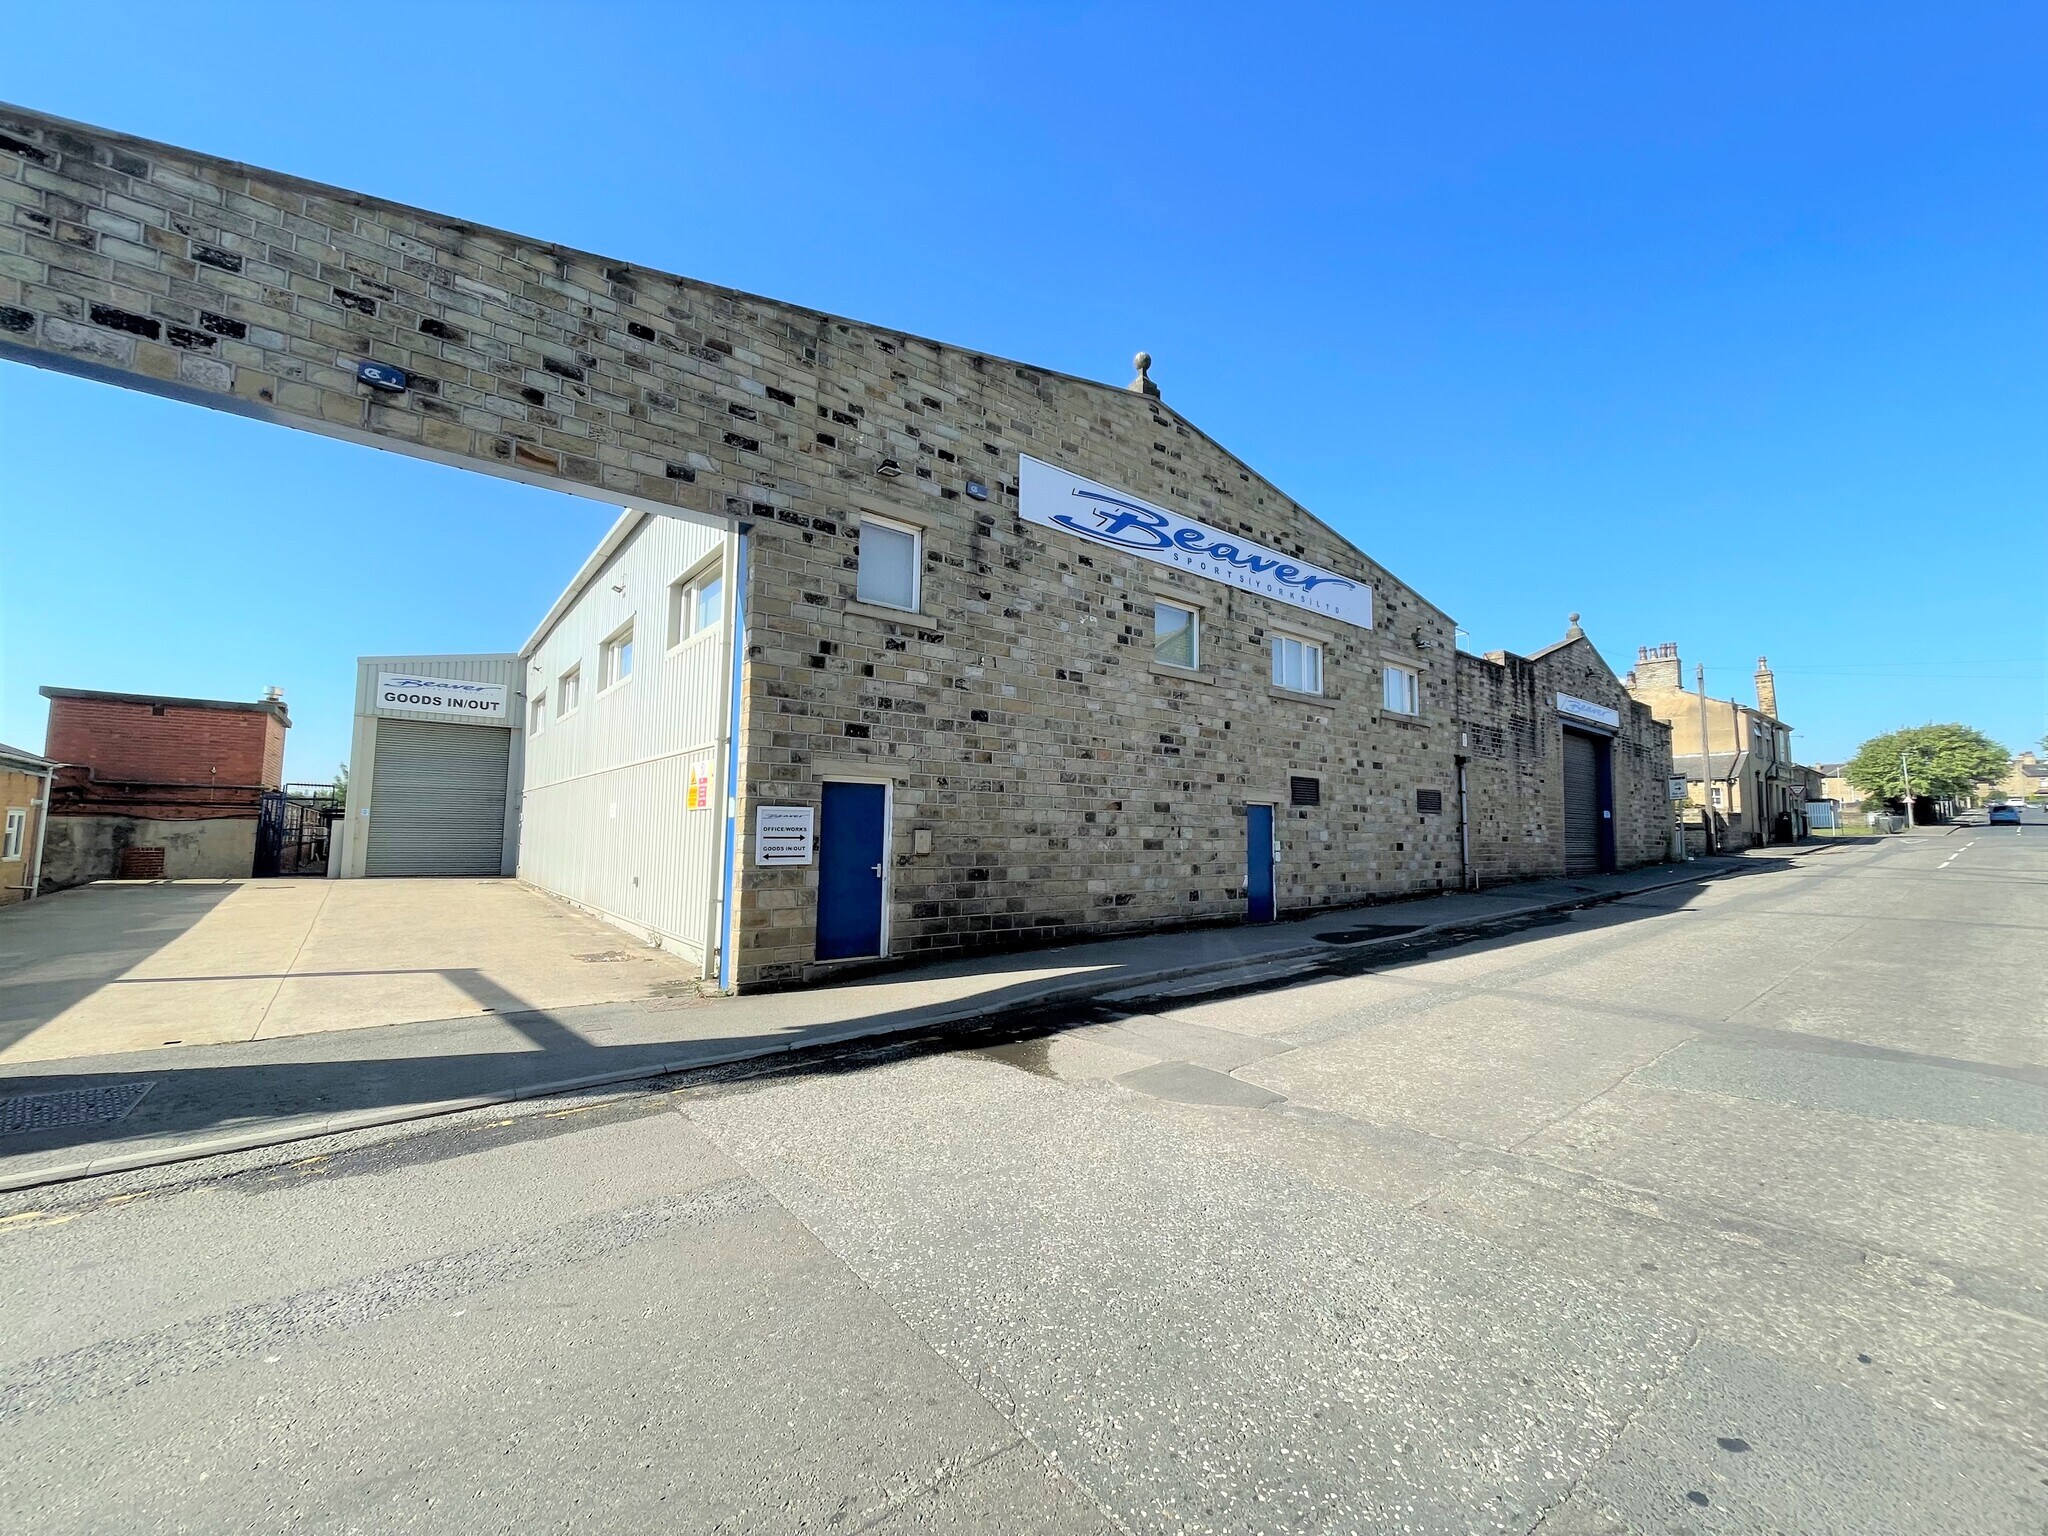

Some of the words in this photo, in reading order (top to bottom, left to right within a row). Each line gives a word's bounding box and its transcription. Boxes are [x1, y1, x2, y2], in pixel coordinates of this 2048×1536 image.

[1048, 488, 1355, 592] Beaver
[384, 678, 502, 692] Beaver
[384, 692, 442, 706] GOODS
[447, 698, 500, 711] IN/OUT
[1565, 700, 1610, 718] Beaver
